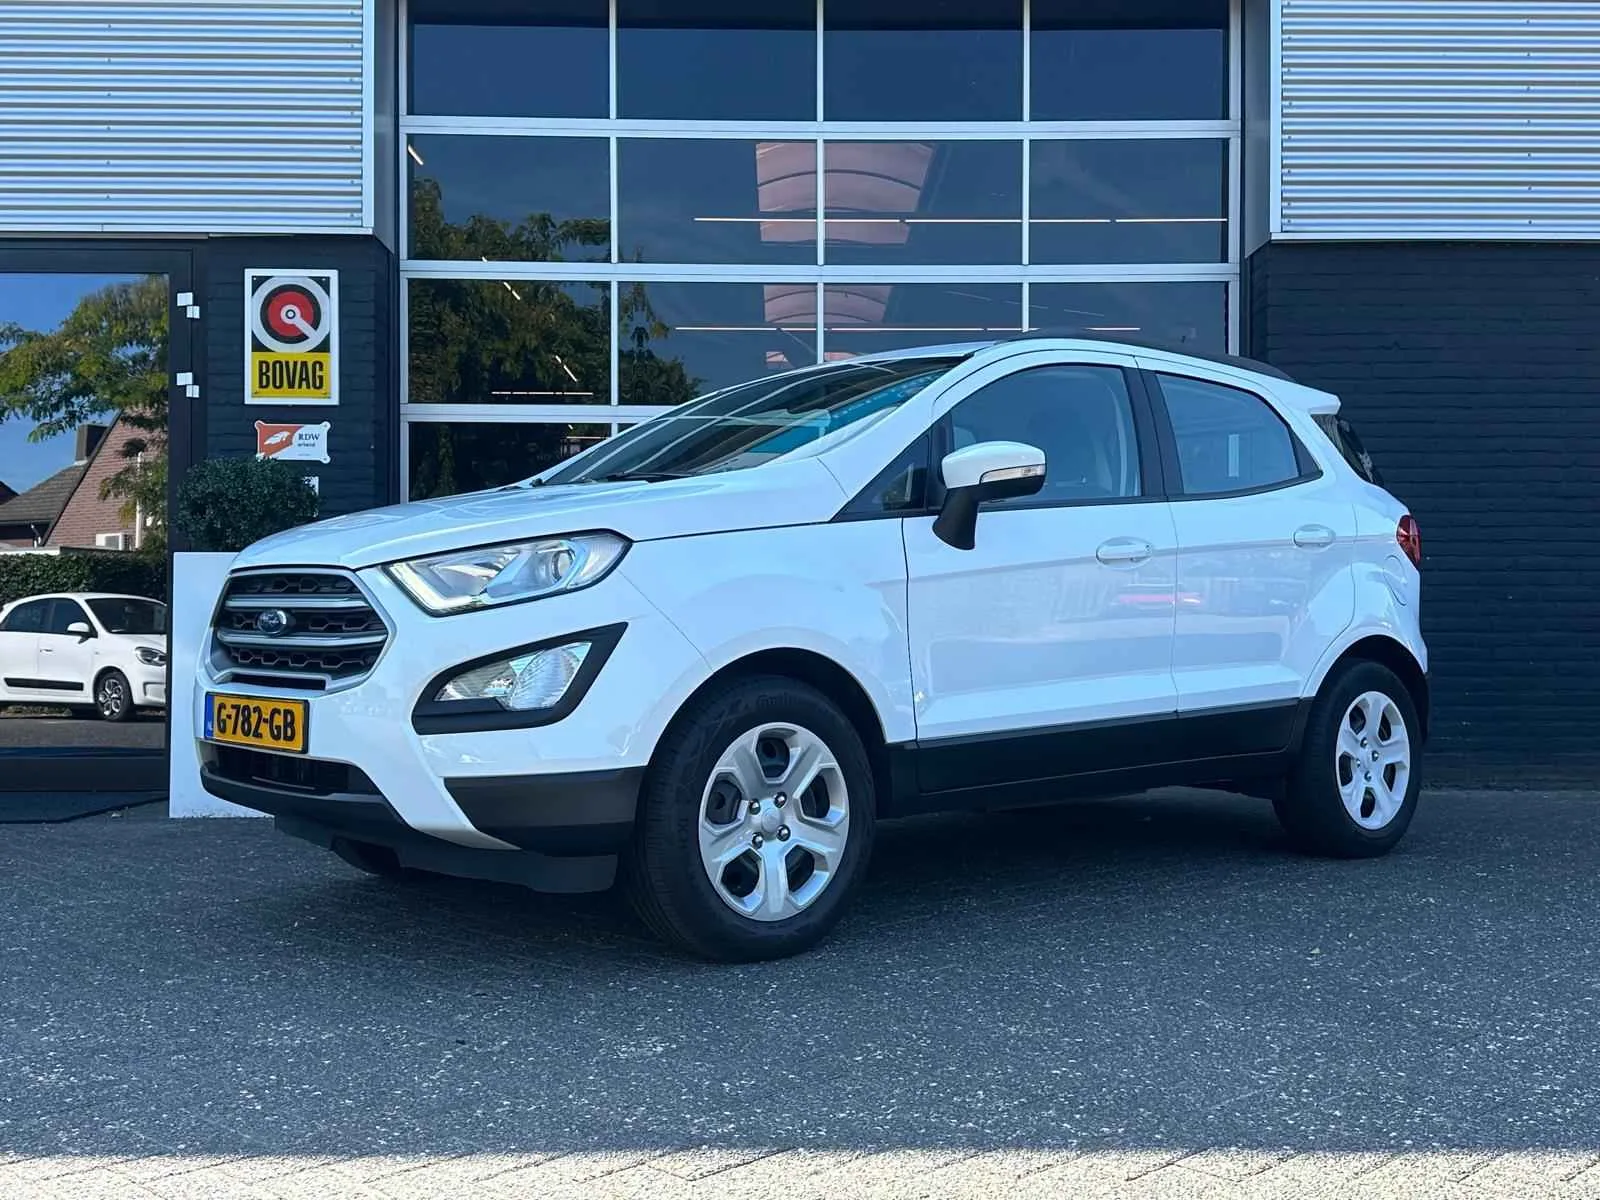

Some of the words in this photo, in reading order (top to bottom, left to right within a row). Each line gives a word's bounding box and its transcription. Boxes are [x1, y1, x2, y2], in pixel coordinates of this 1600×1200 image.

[258, 359, 324, 390] BOVAG
[298, 432, 321, 441] RDW
[216, 702, 296, 742] G-782-GB
